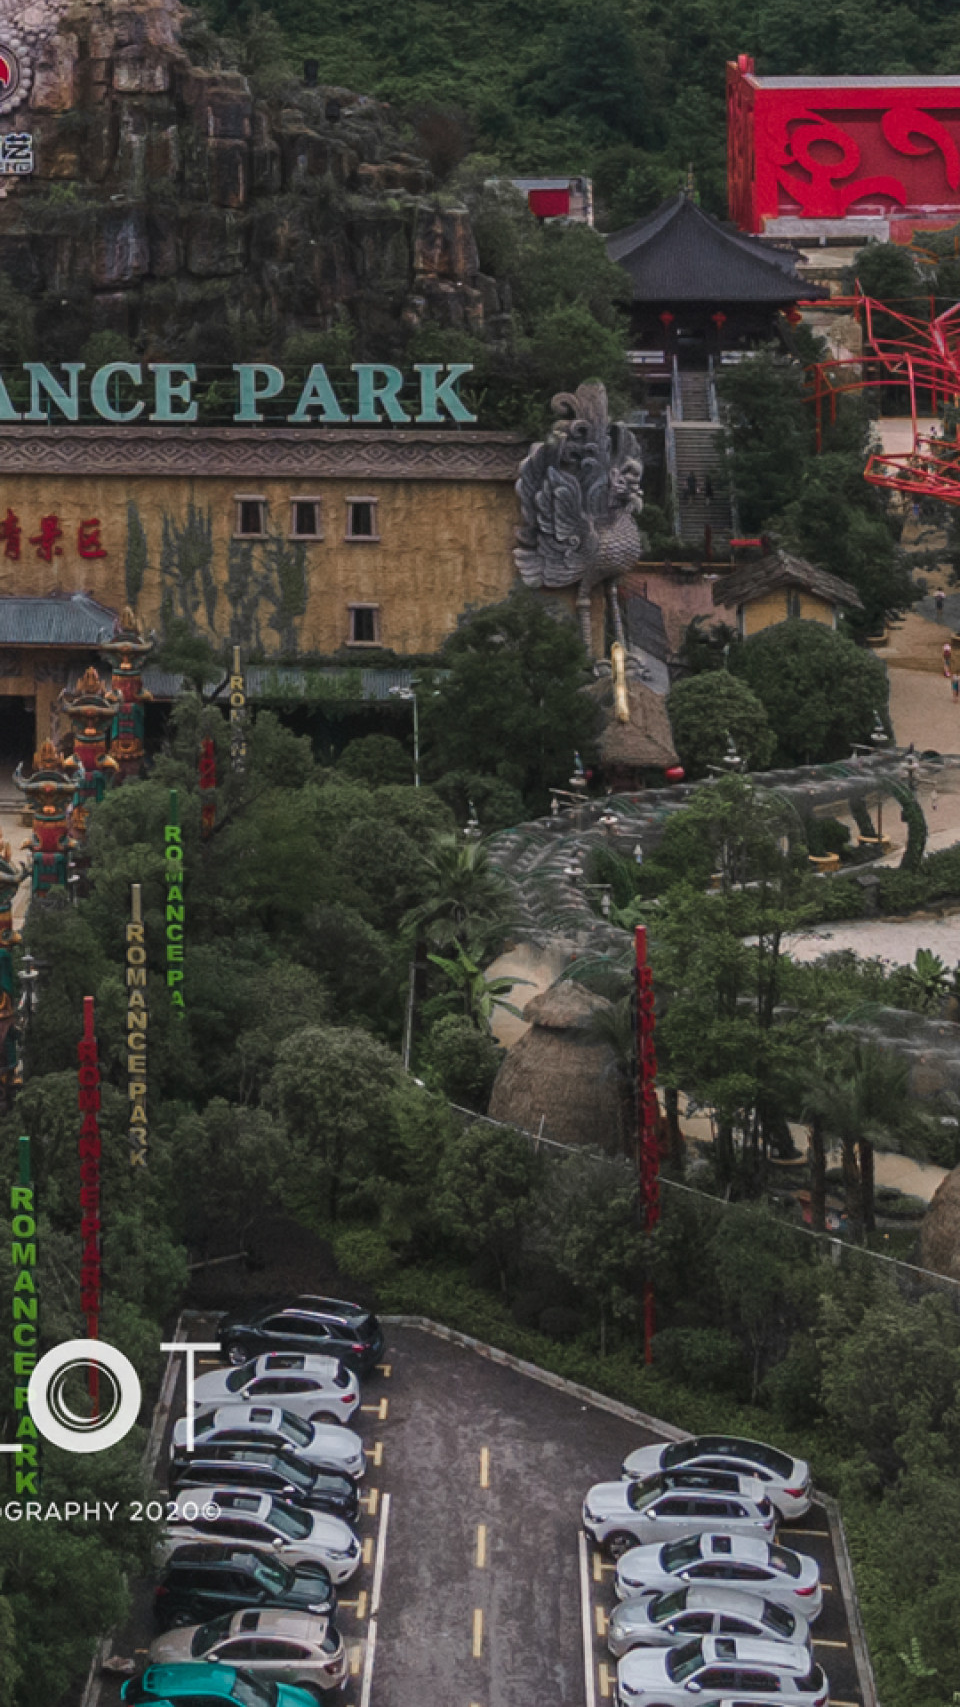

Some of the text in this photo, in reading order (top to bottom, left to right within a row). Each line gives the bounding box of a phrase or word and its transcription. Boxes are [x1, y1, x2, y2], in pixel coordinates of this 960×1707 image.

[234, 364, 477, 423] PARK
[126, 924, 148, 1167] ROMANCE PARK
[78, 1040, 101, 1314] ROMANCE PARK
[11, 1187, 38, 1494] ROMANCE PARK
